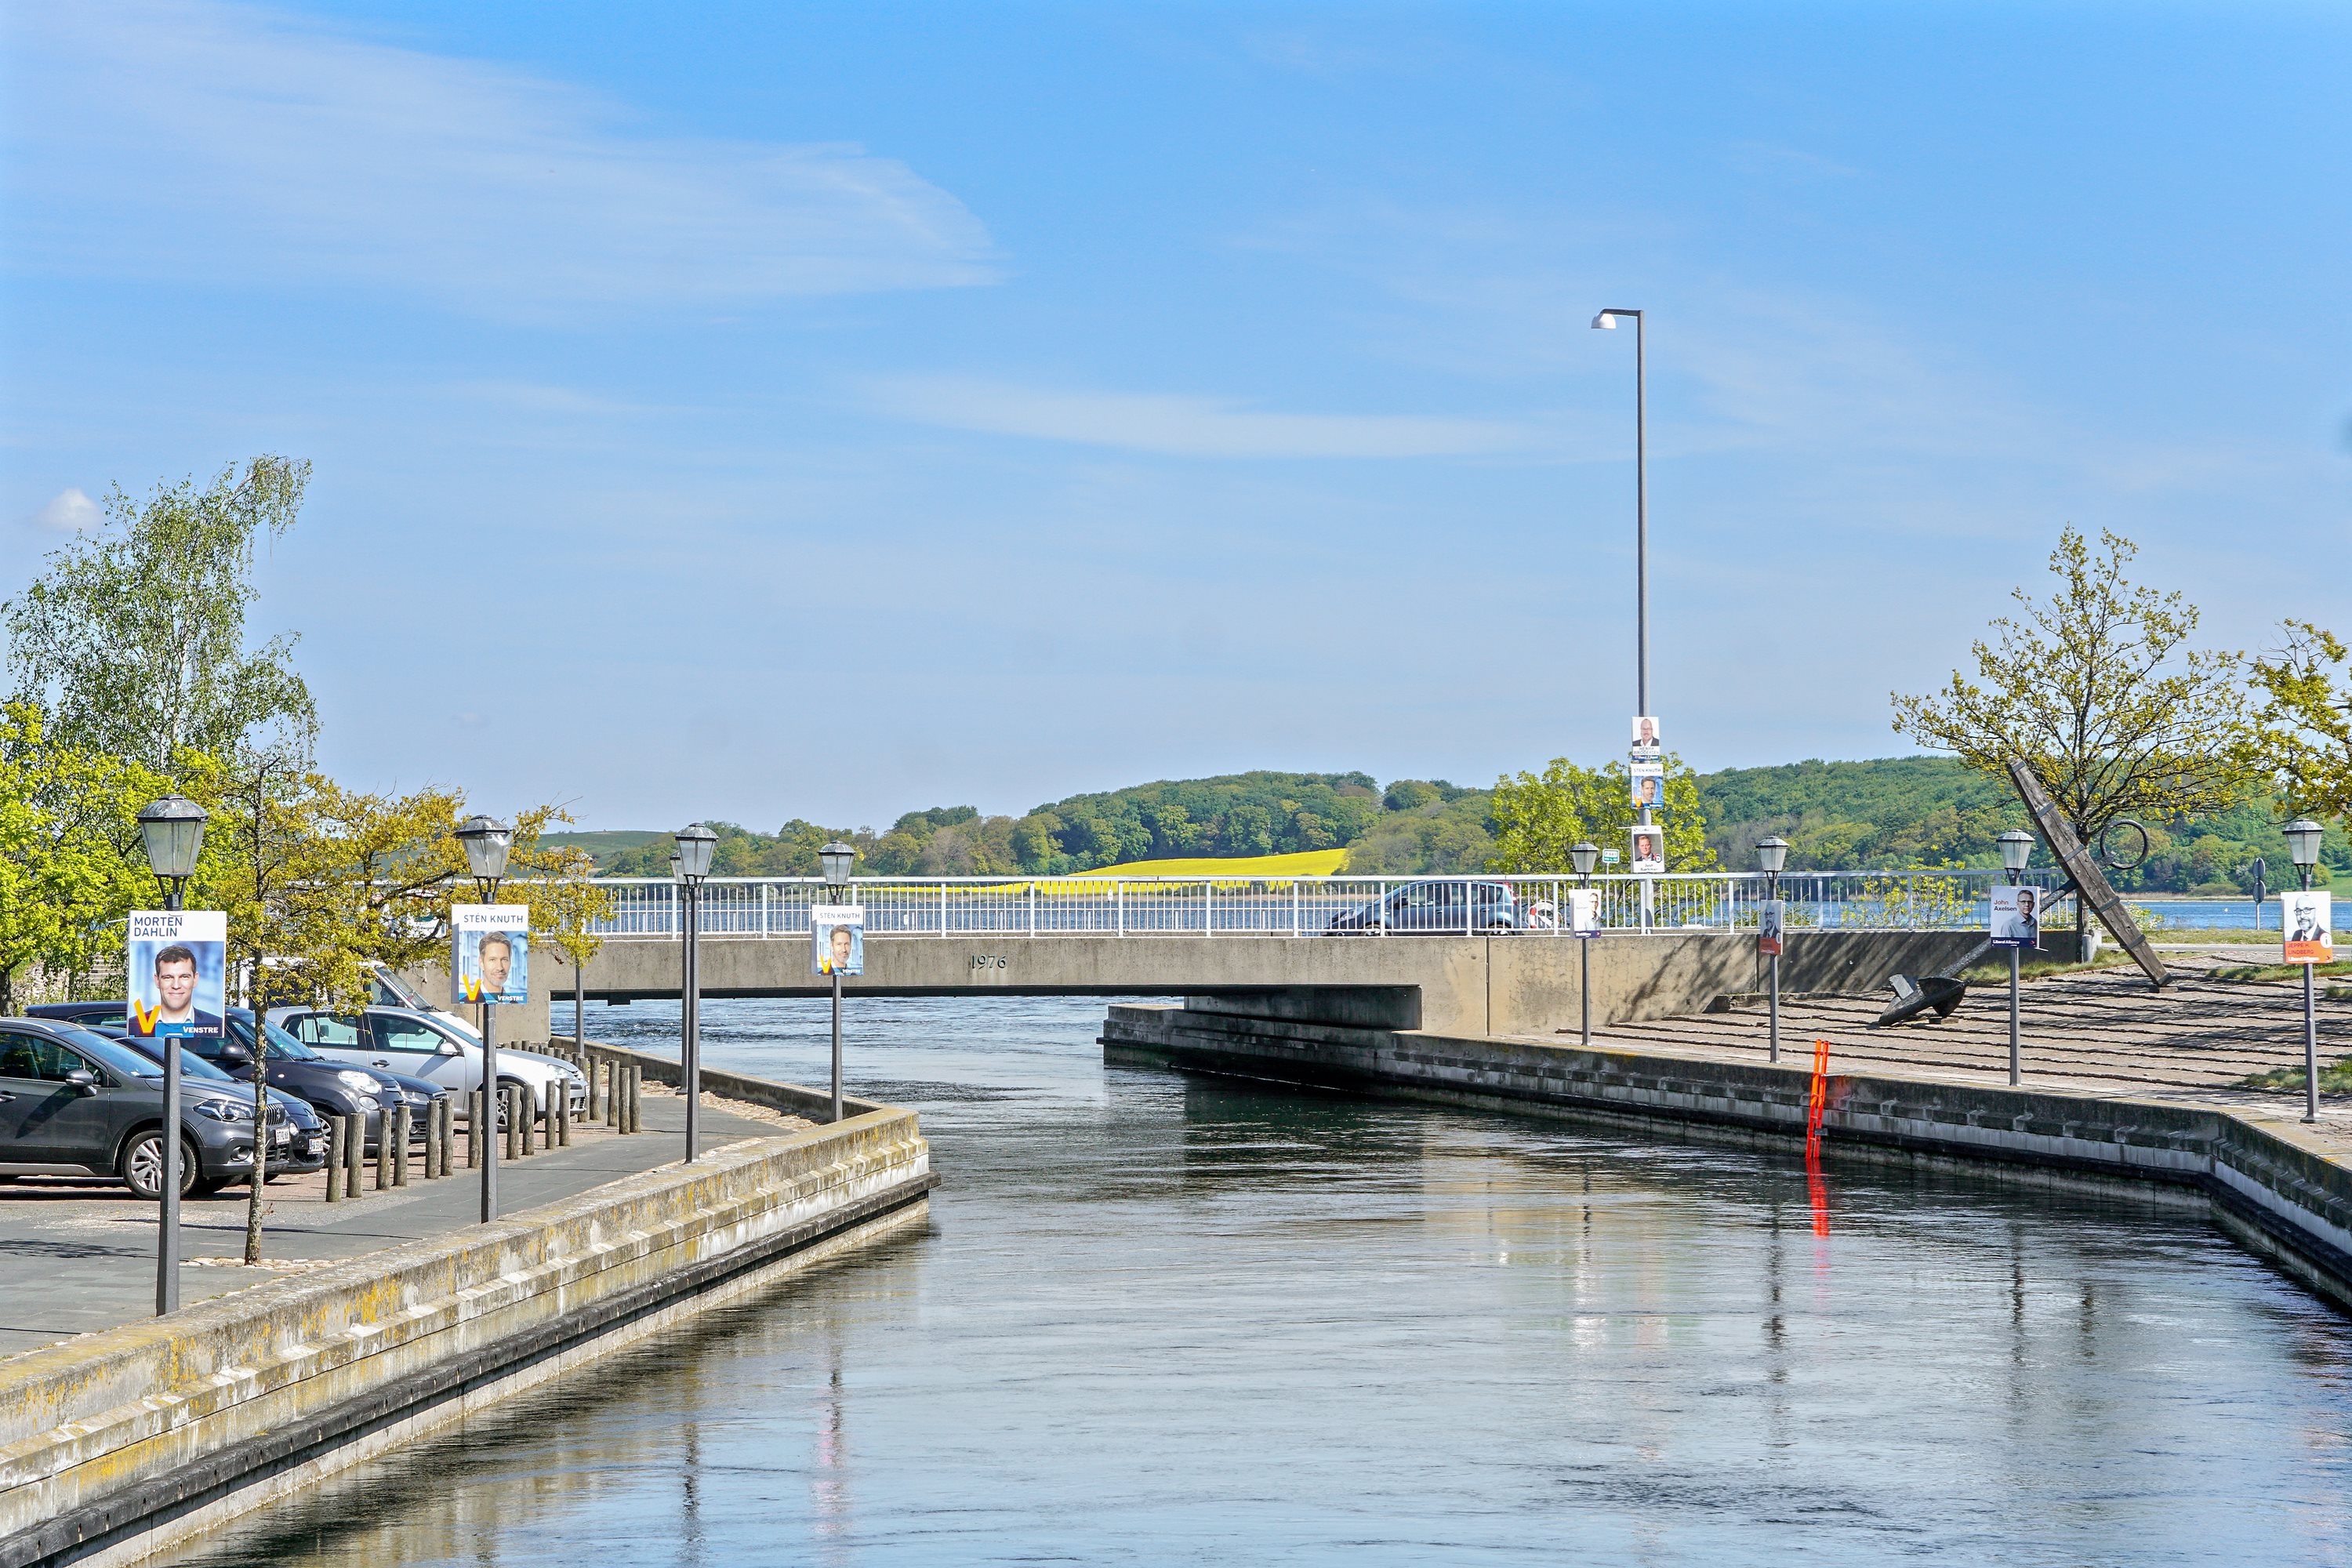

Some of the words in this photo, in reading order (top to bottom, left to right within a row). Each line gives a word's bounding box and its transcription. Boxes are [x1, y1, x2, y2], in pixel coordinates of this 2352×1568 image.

[134, 916, 183, 927] MORTEN
[490, 915, 524, 924] KNUTH
[134, 927, 178, 937] DAHLIN
[972, 954, 1007, 970] 1976
